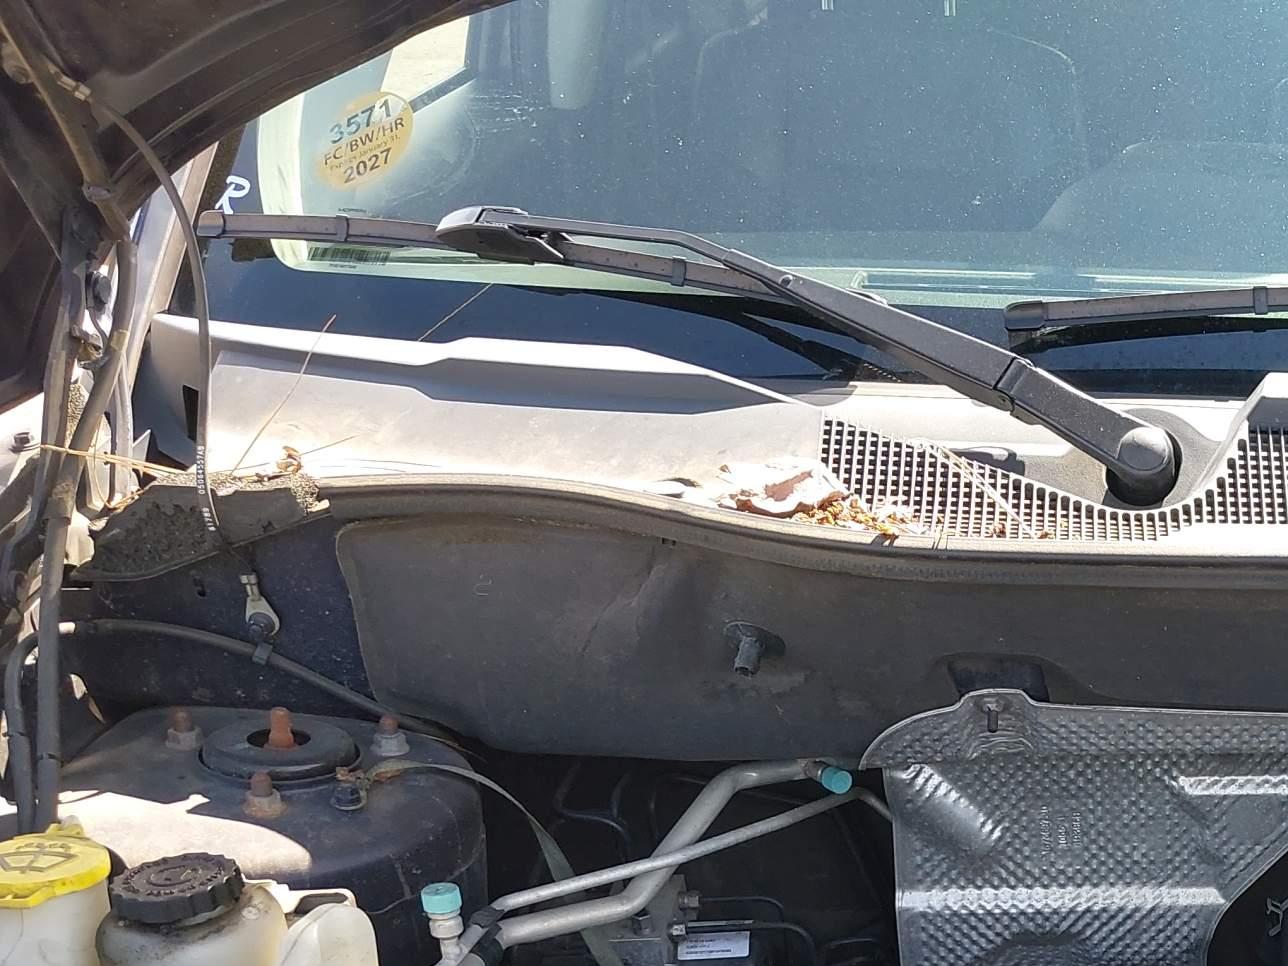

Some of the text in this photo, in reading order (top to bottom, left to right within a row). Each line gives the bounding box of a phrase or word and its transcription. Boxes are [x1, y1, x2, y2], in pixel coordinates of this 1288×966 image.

[323, 117, 405, 166] FC/BW/HR
[329, 98, 392, 145] 3571
[343, 147, 392, 184] 2027
